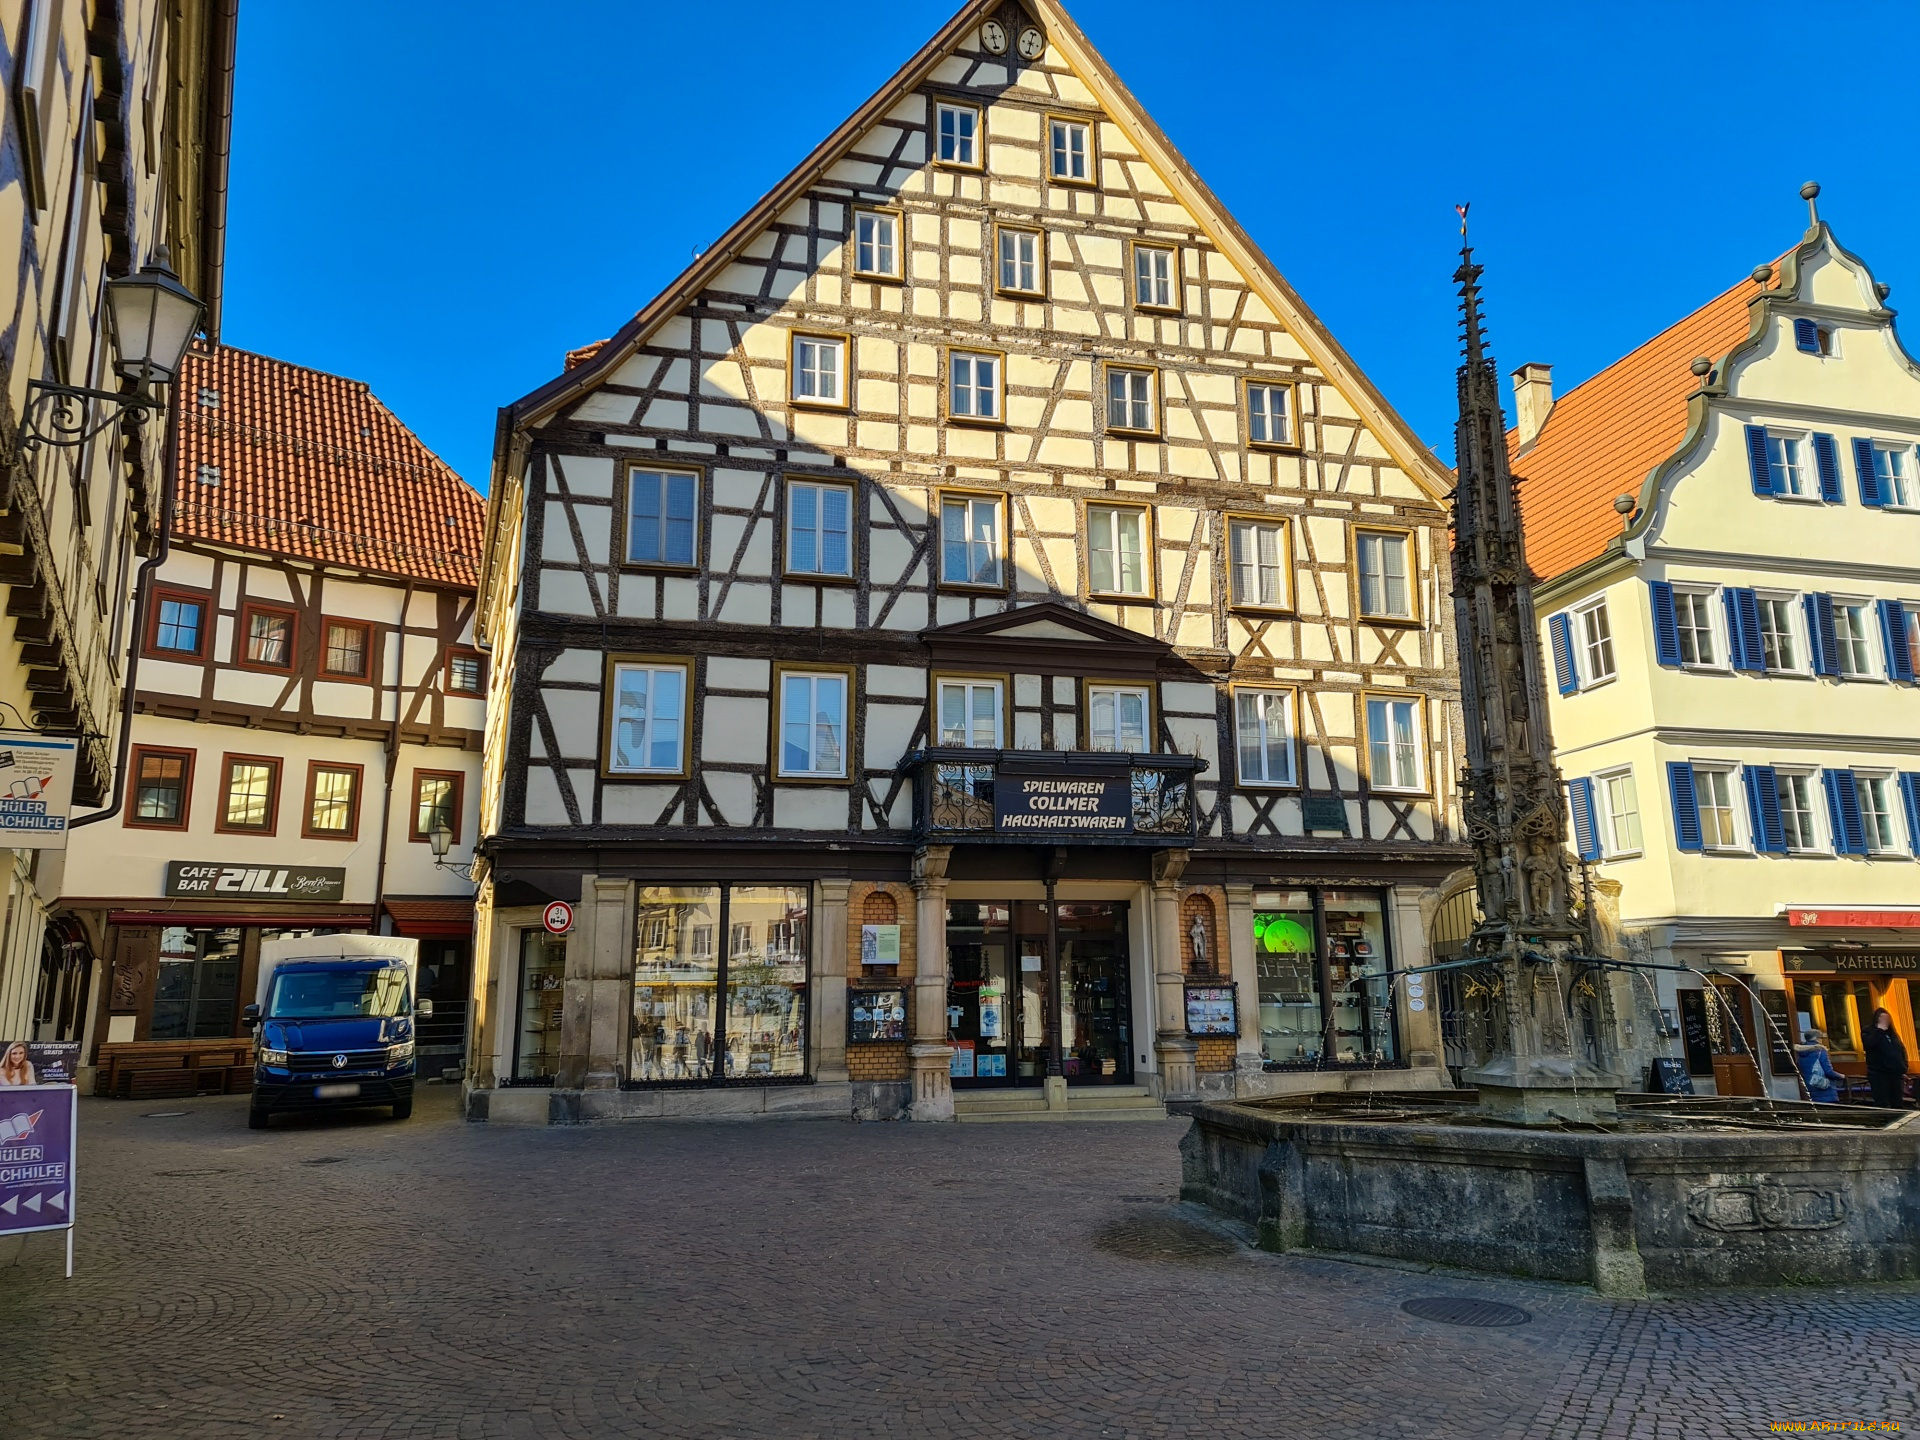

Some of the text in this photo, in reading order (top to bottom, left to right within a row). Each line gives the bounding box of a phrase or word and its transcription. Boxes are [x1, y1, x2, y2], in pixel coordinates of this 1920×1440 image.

[1022, 780, 1105, 795] SPIELWAREN
[1029, 796, 1100, 812] COLLMER
[1001, 814, 1127, 829] HAUSHALTSWAREN
[179, 866, 218, 878] CAFE
[177, 880, 209, 891] BAR
[1836, 955, 1917, 969] KAFFEEHAUS
